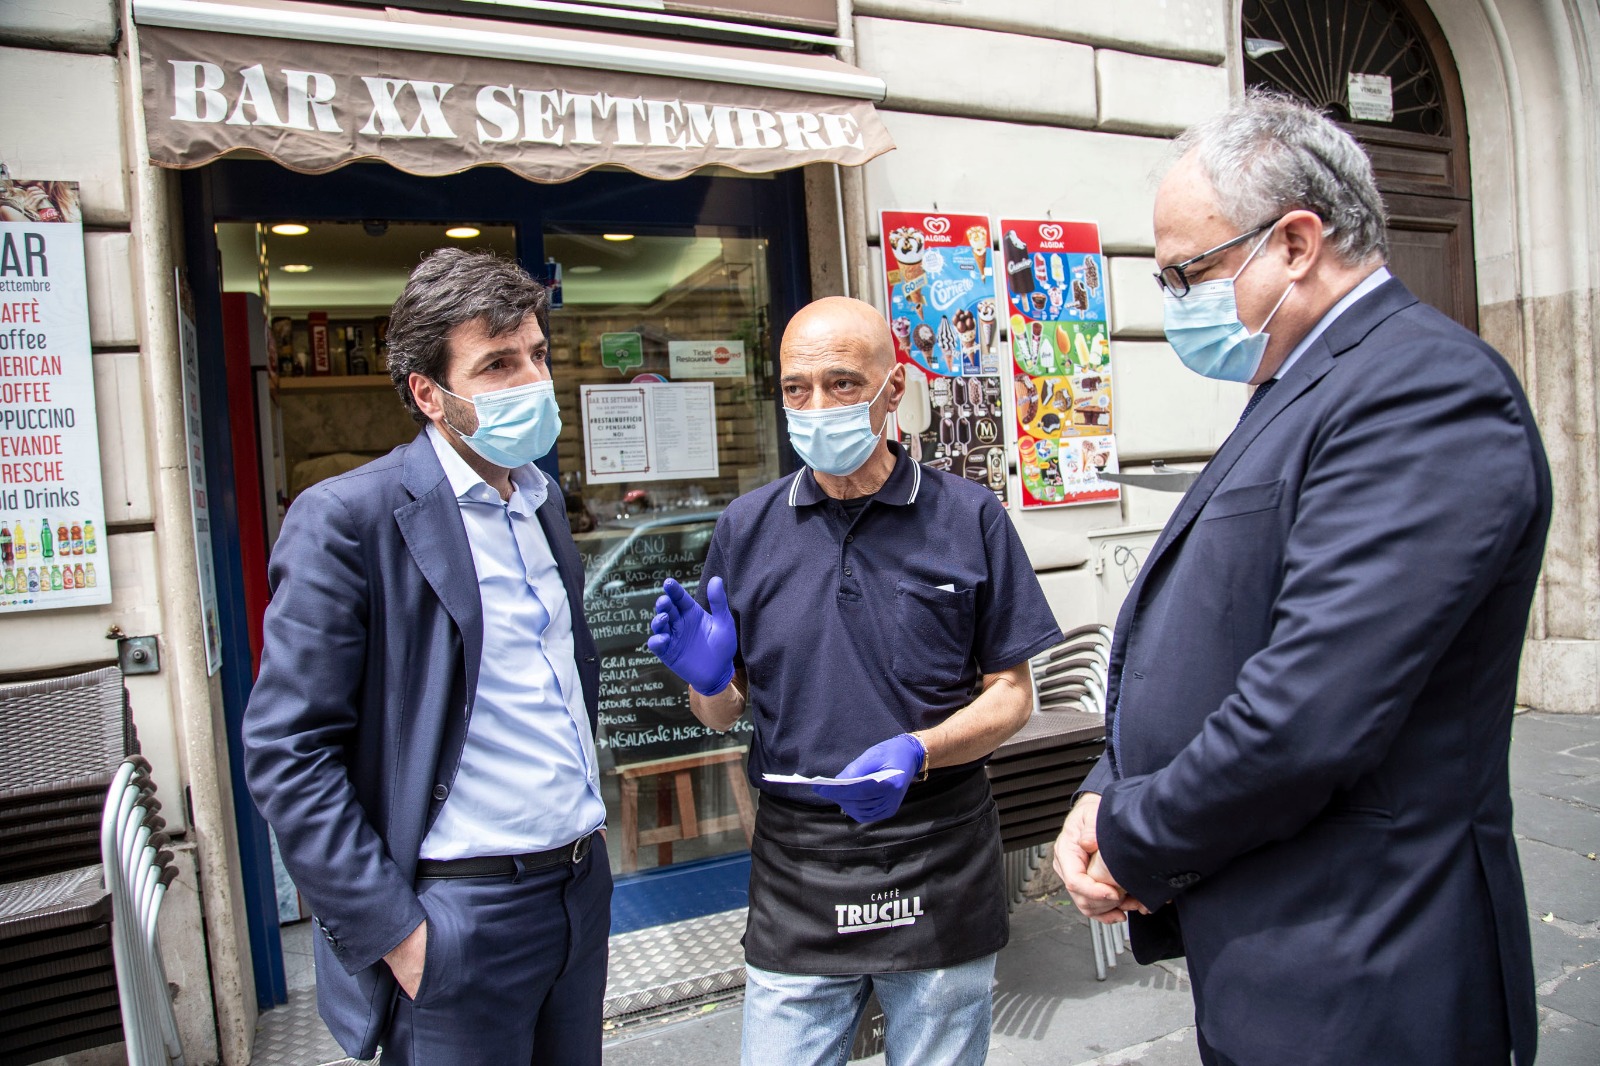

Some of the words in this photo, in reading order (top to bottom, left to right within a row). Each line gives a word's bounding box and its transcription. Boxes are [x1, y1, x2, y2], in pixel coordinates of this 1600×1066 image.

[168, 60, 343, 133] BAR
[359, 77, 457, 138] XX
[475, 84, 864, 150] SETTEMBRE
[0, 232, 48, 277] AR
[0, 280, 51, 291] ettembre
[905, 282, 915, 293] 60
[930, 279, 974, 311] Cornetto
[2, 298, 40, 323] AFFÈ
[0, 329, 46, 349] offee
[0, 356, 62, 377] ERICAN
[0, 383, 51, 403] OFFEE
[0, 408, 75, 430] PUCCINO
[1, 435, 63, 457] EVANDE
[2, 461, 65, 484] RESCHE
[0, 490, 18, 511] ld
[24, 487, 80, 510] Drinks
[642, 551, 695, 566] ORTOLANA
[584, 586, 635, 600] NSALATA
[583, 597, 630, 612] CAPRESE
[599, 668, 639, 682] SALATA
[871, 888, 899, 901] CAFFÈ
